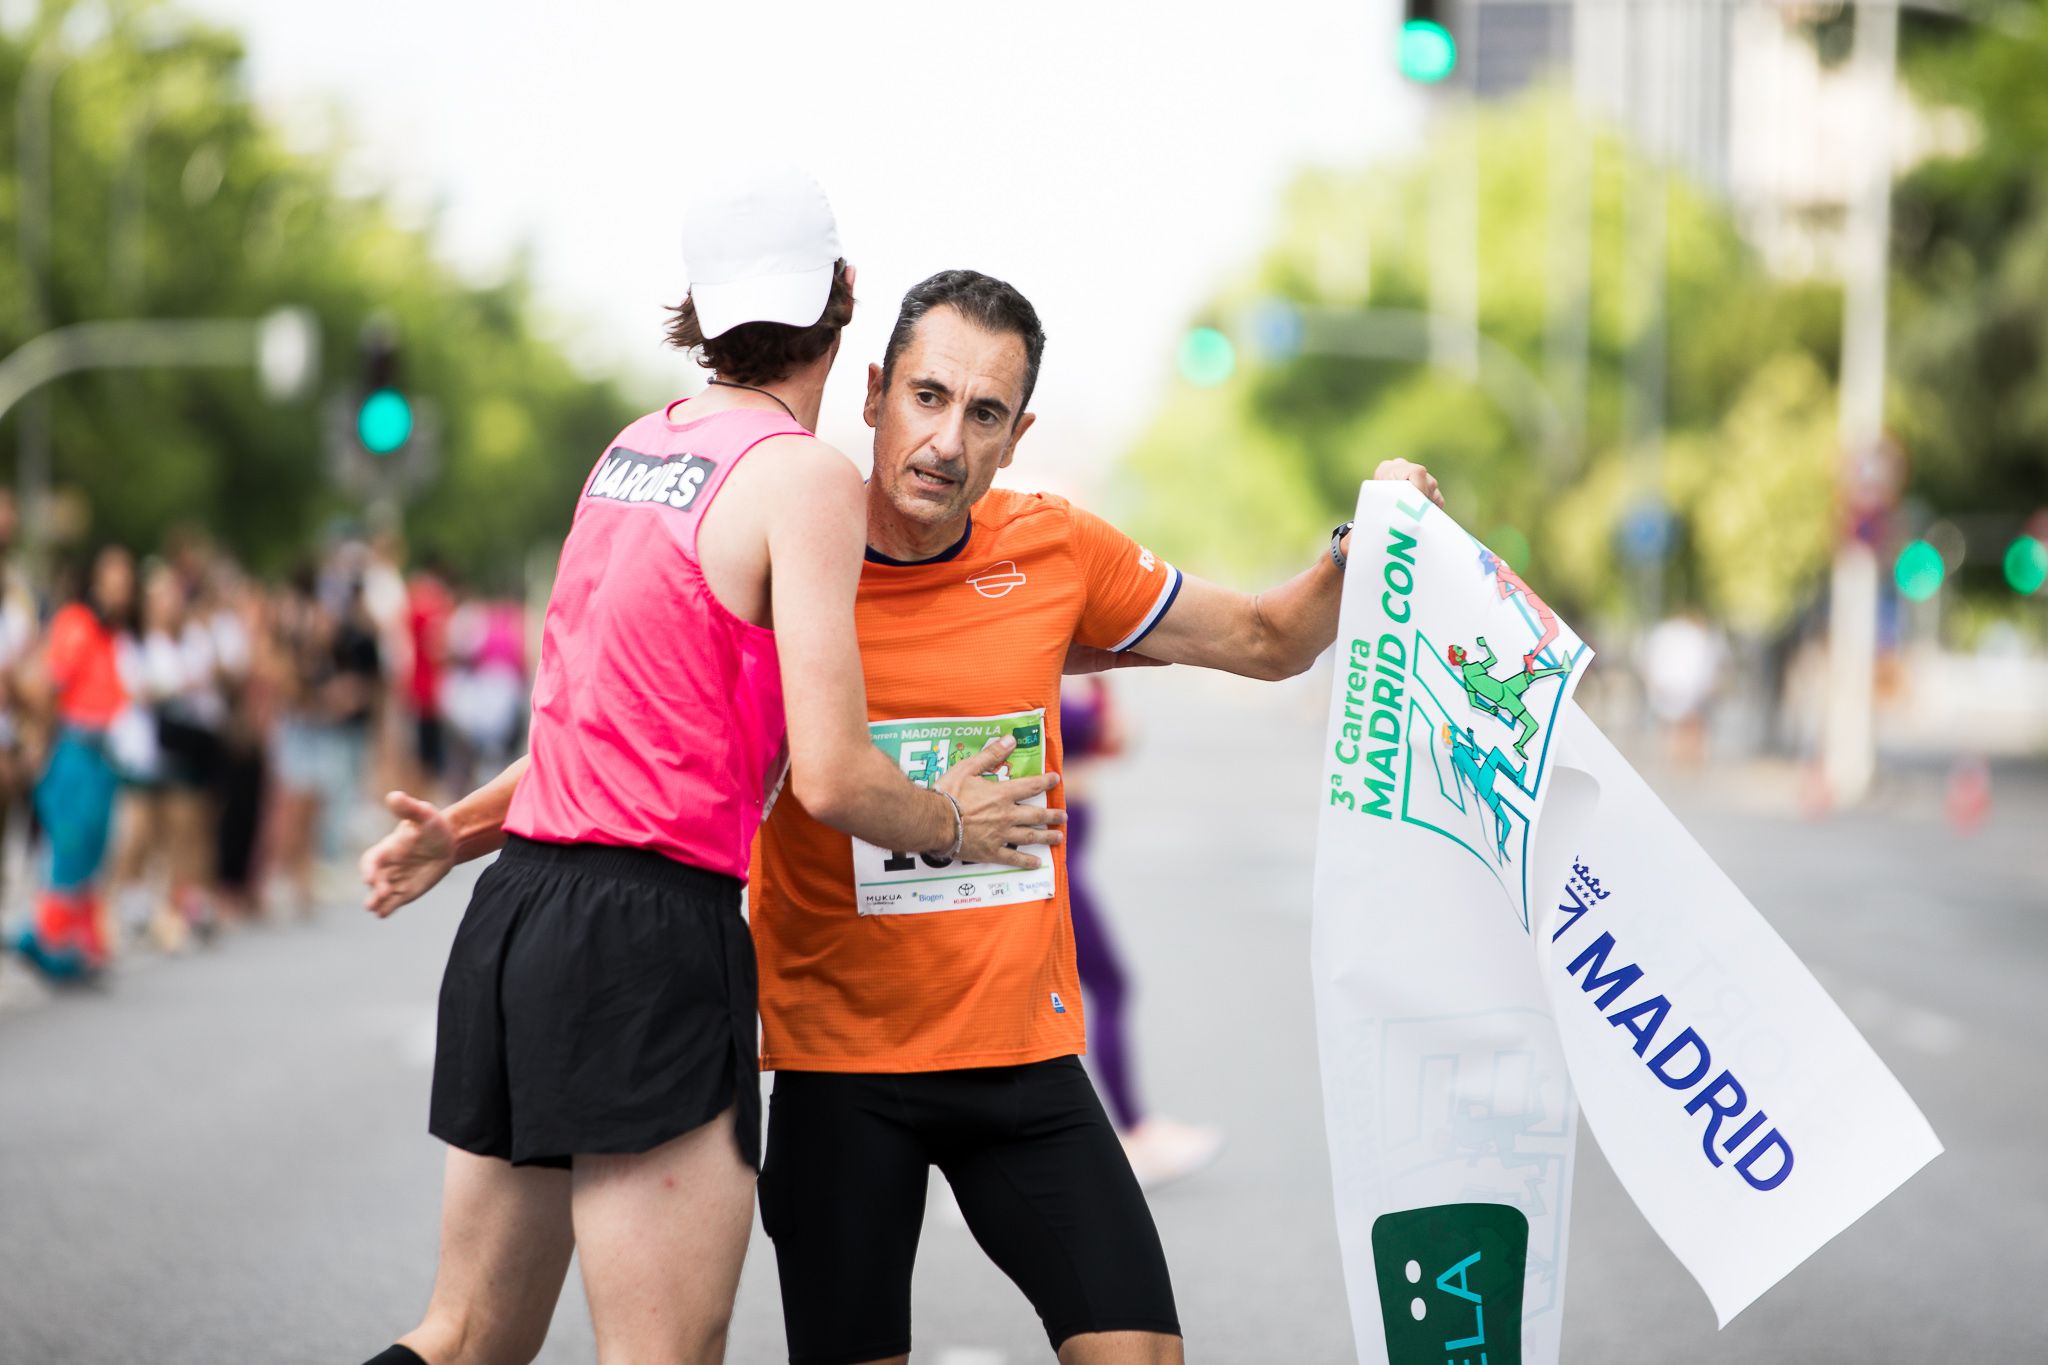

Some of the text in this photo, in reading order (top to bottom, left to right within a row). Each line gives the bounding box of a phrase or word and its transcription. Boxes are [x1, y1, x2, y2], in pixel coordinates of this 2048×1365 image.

[1335, 638, 1372, 765] Carrera
[1361, 498, 1432, 820] MADRID CON L
[871, 725, 1002, 742] arrera MADRID CON LA
[866, 894, 944, 903] MUKUA Biogen
[1566, 930, 1795, 1192] MADRID
